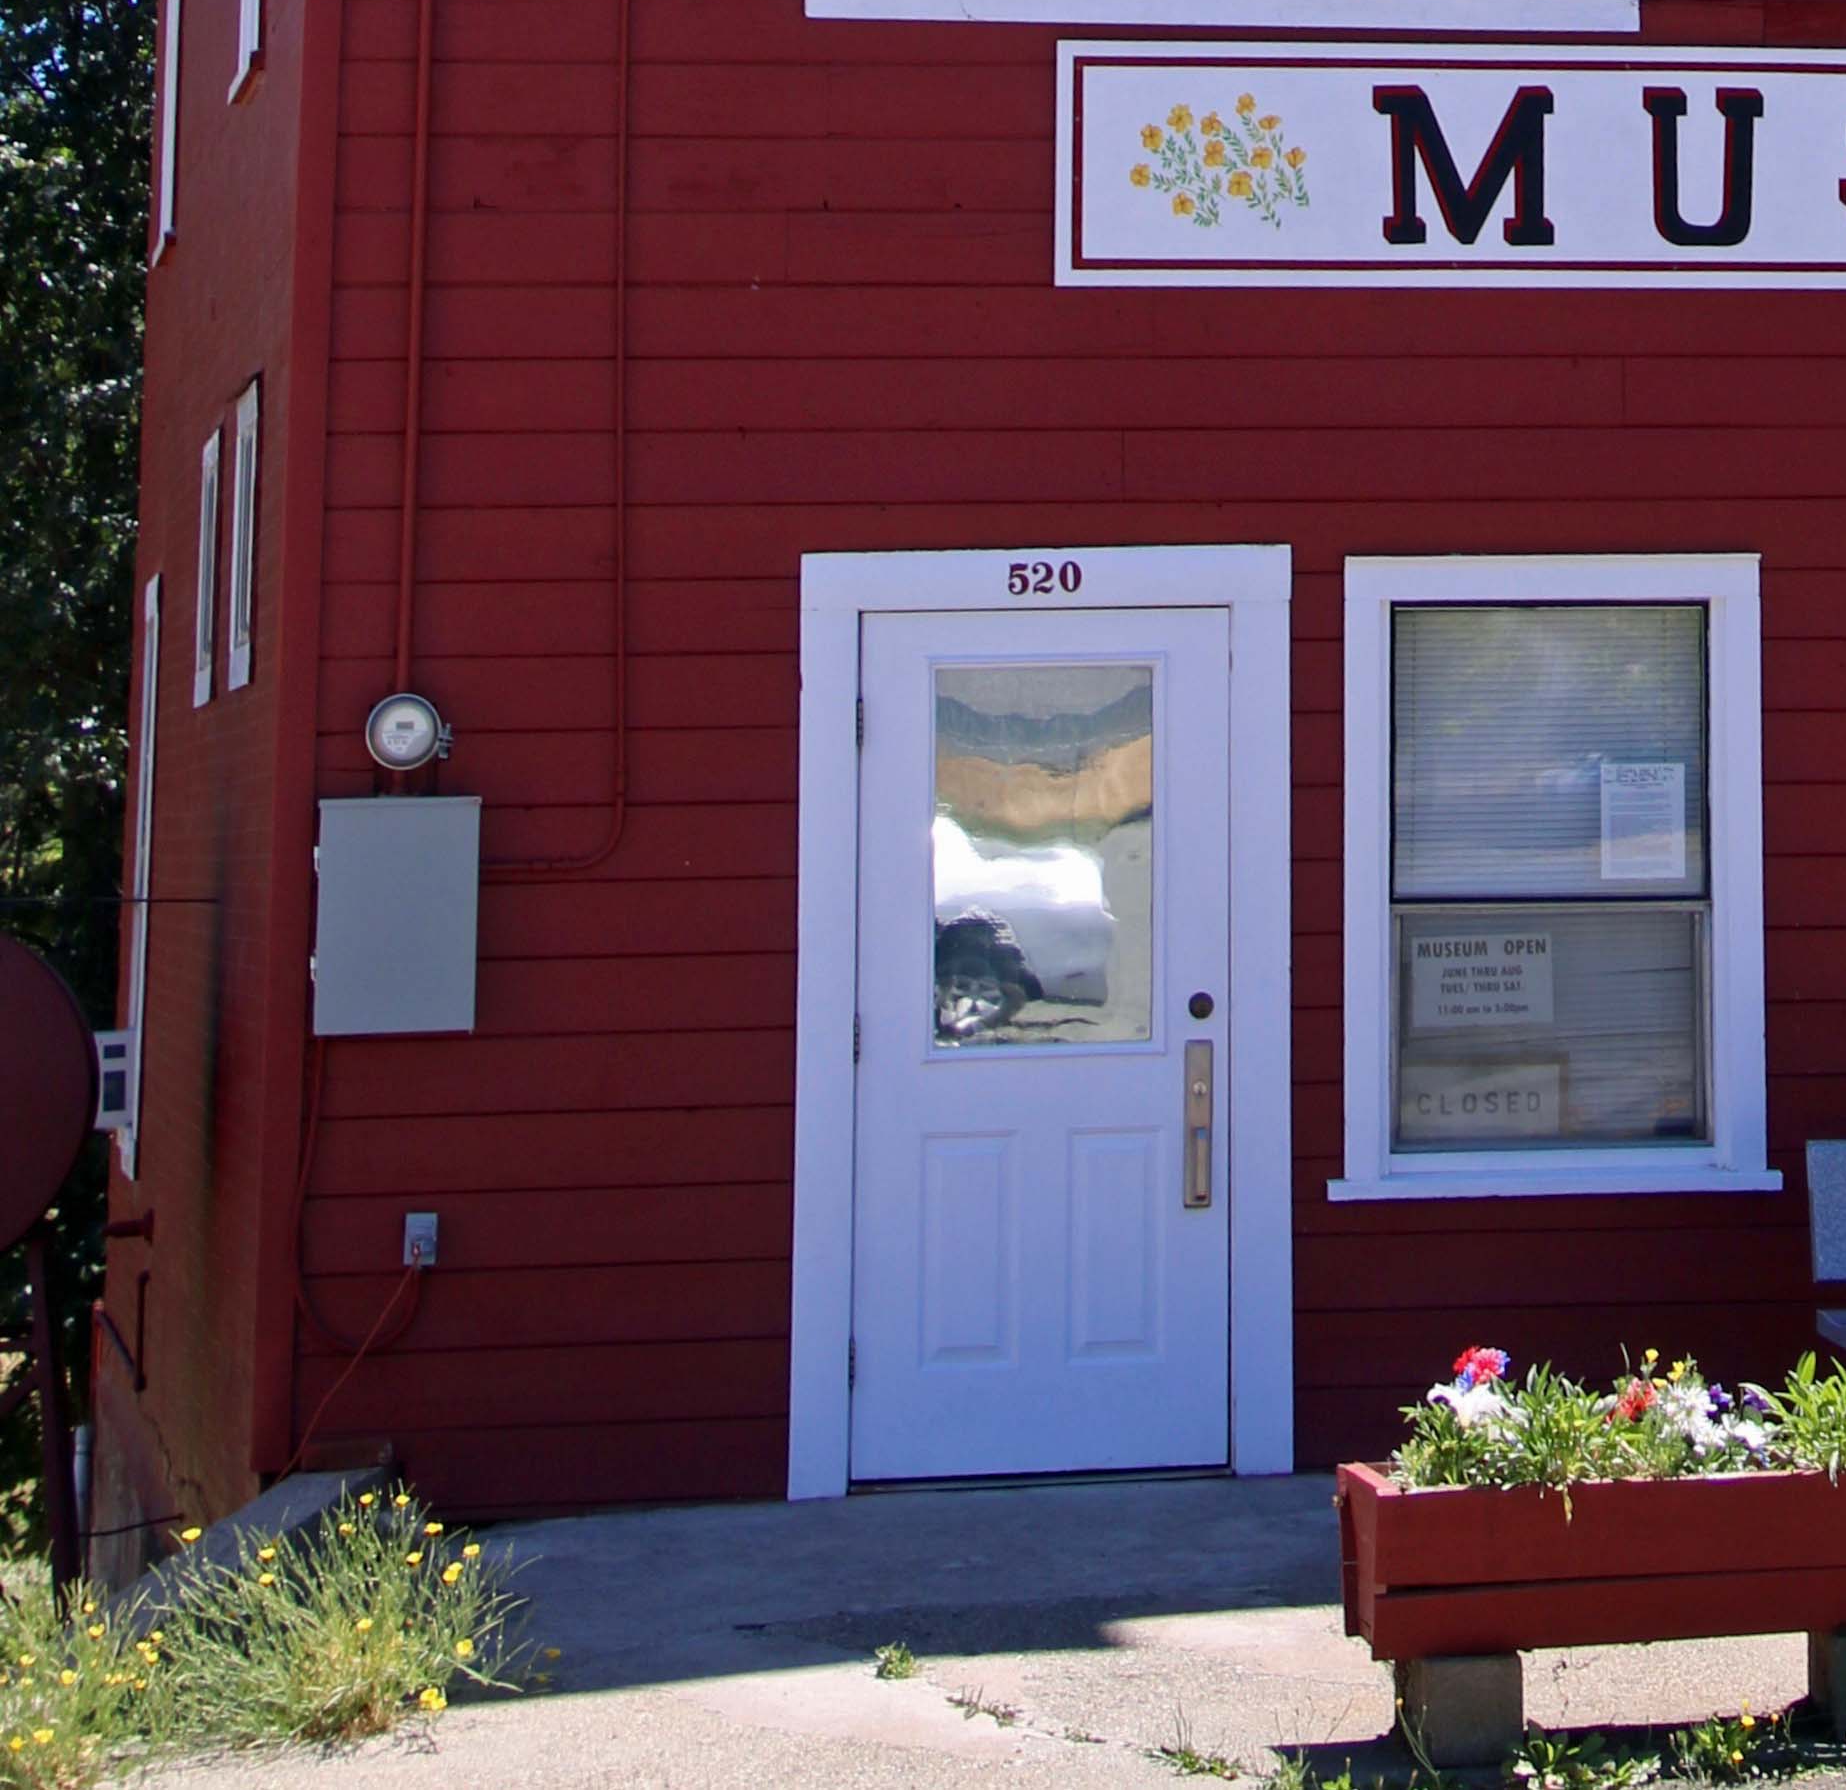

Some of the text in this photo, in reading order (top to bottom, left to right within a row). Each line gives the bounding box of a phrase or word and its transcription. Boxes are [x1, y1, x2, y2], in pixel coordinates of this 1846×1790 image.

[1008, 561, 1082, 595] 520
[1417, 938, 1547, 958] MUSEUM OPEN
[1442, 964, 1523, 979] JUNE THRU AUG
[1473, 981, 1500, 993] THRU
[1417, 1091, 1541, 1115] CLOSED
